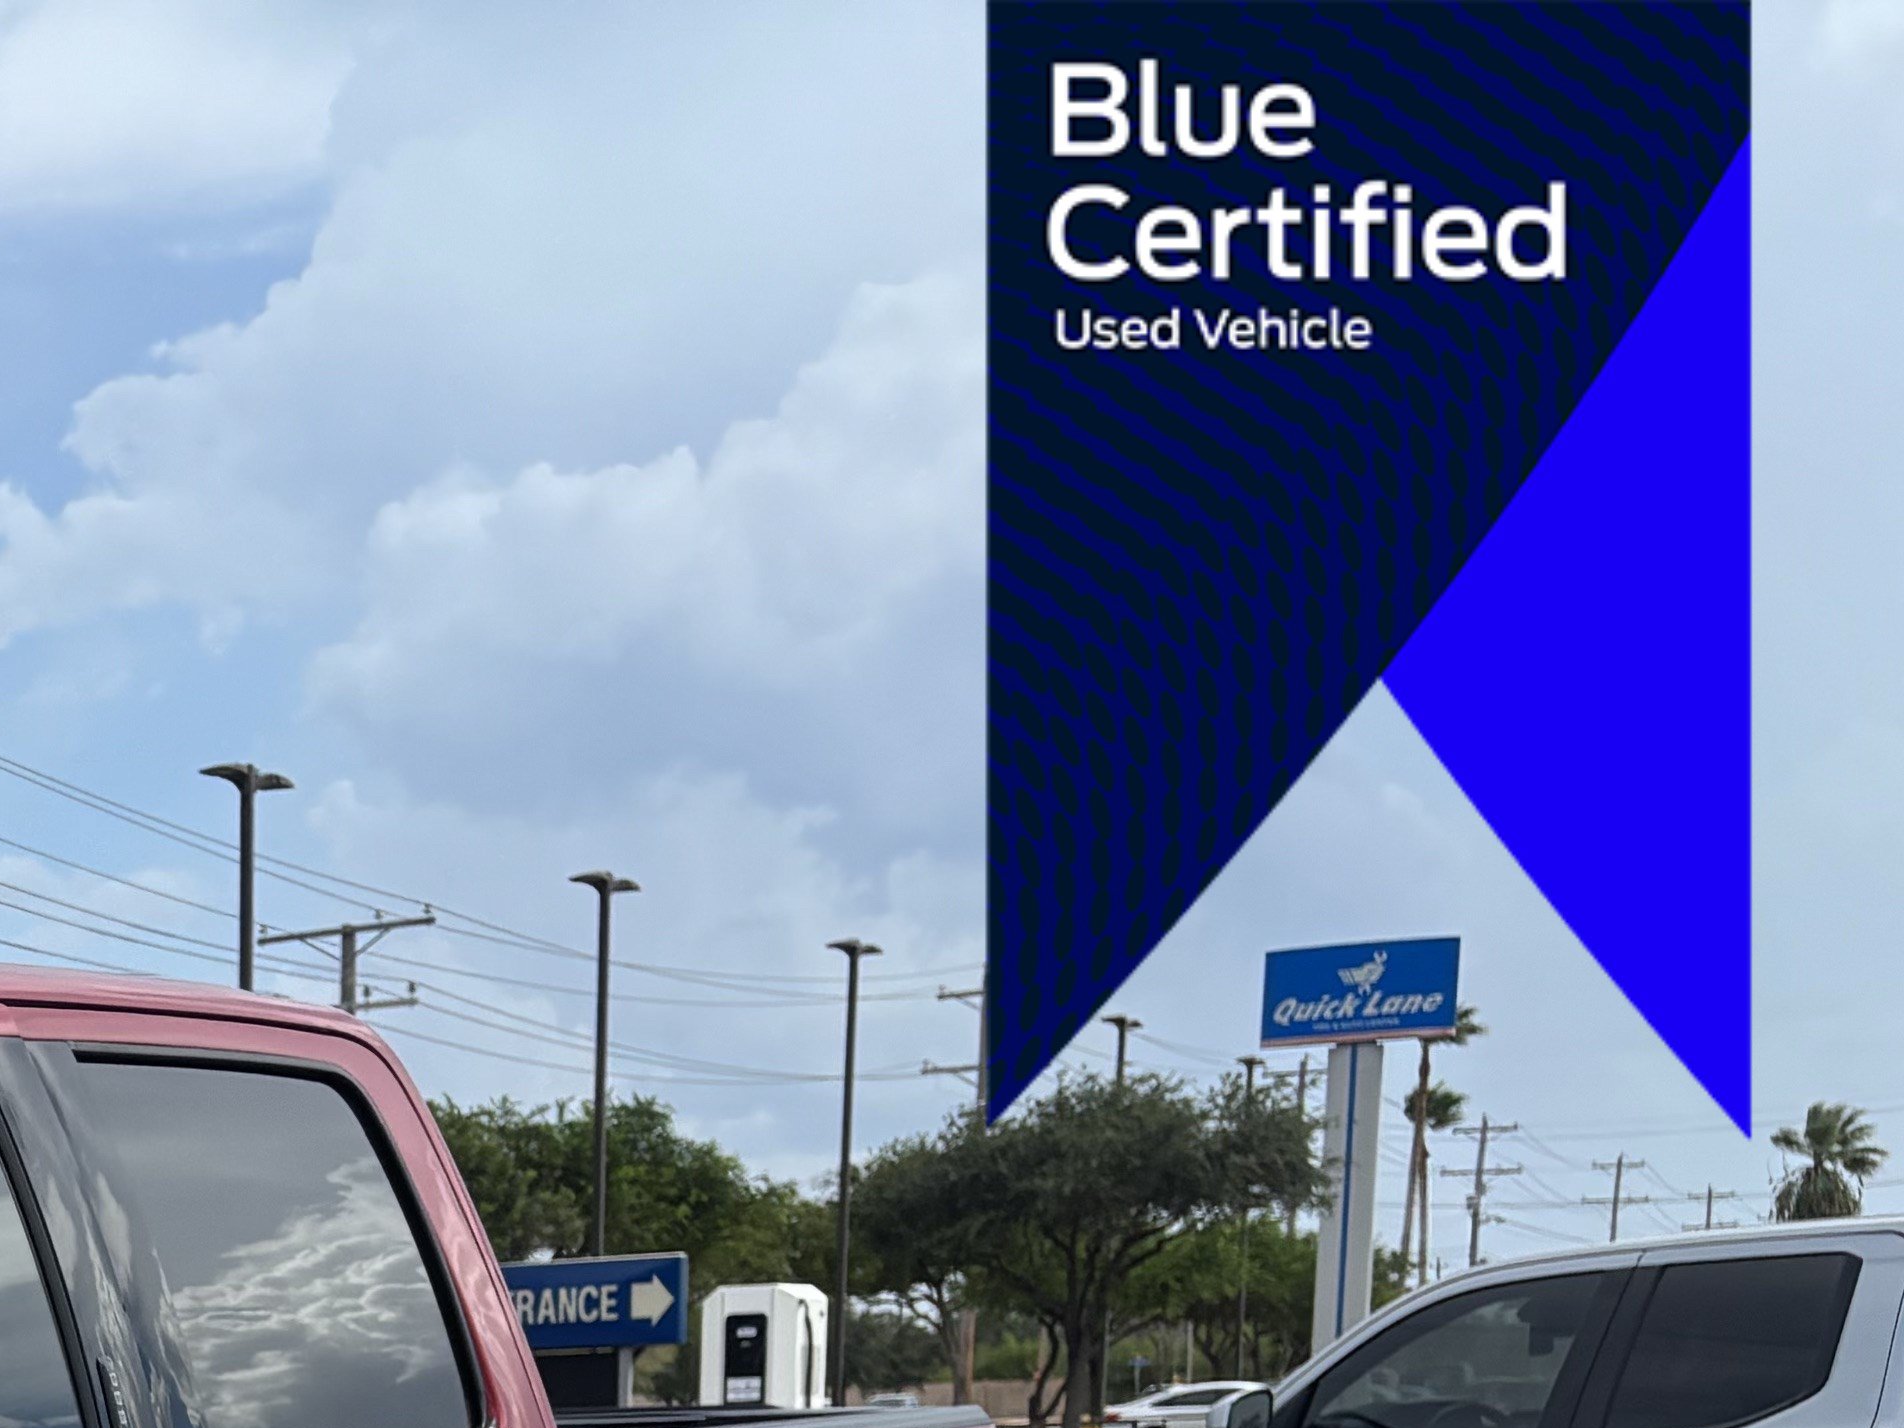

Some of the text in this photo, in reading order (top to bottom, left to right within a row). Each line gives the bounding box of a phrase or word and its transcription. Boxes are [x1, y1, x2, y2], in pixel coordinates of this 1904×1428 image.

[1273, 992, 1361, 1026] Quick
[1362, 989, 1443, 1017] Lane
[510, 1284, 619, 1326] RANCE
